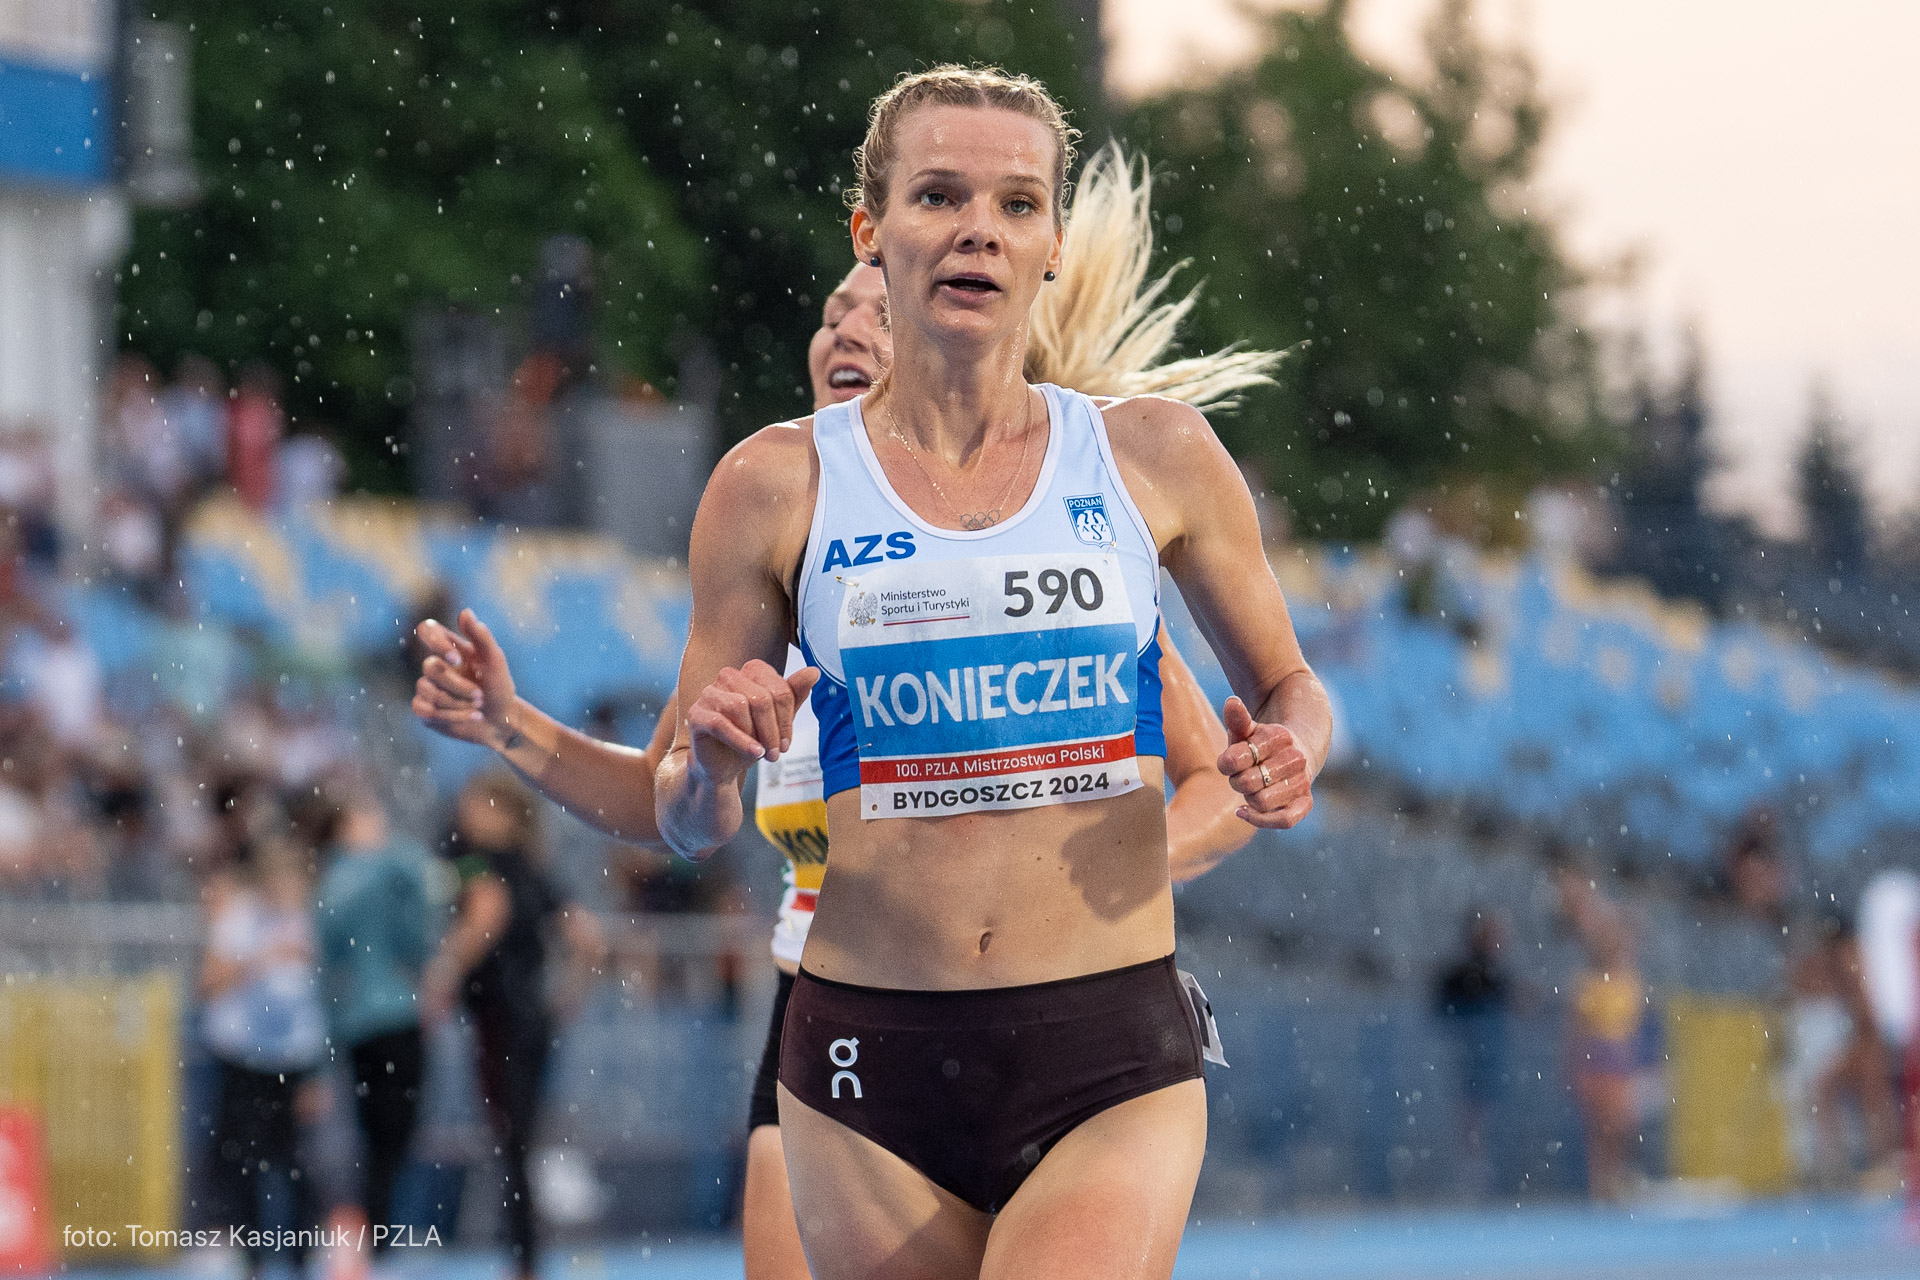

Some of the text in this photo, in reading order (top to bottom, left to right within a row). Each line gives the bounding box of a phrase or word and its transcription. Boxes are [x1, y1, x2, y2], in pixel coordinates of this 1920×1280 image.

[822, 531, 917, 574] AZS
[881, 588, 946, 602] Ministerstwo
[881, 604, 915, 616] Sportu
[922, 597, 970, 612] Turystyki
[1003, 567, 1104, 618] 590
[855, 651, 1130, 728] KONIECZEK
[895, 744, 1105, 778] 100. PZLA Mistrzostwa Polski
[893, 772, 1110, 810] BYDGOSZCZ 2024
